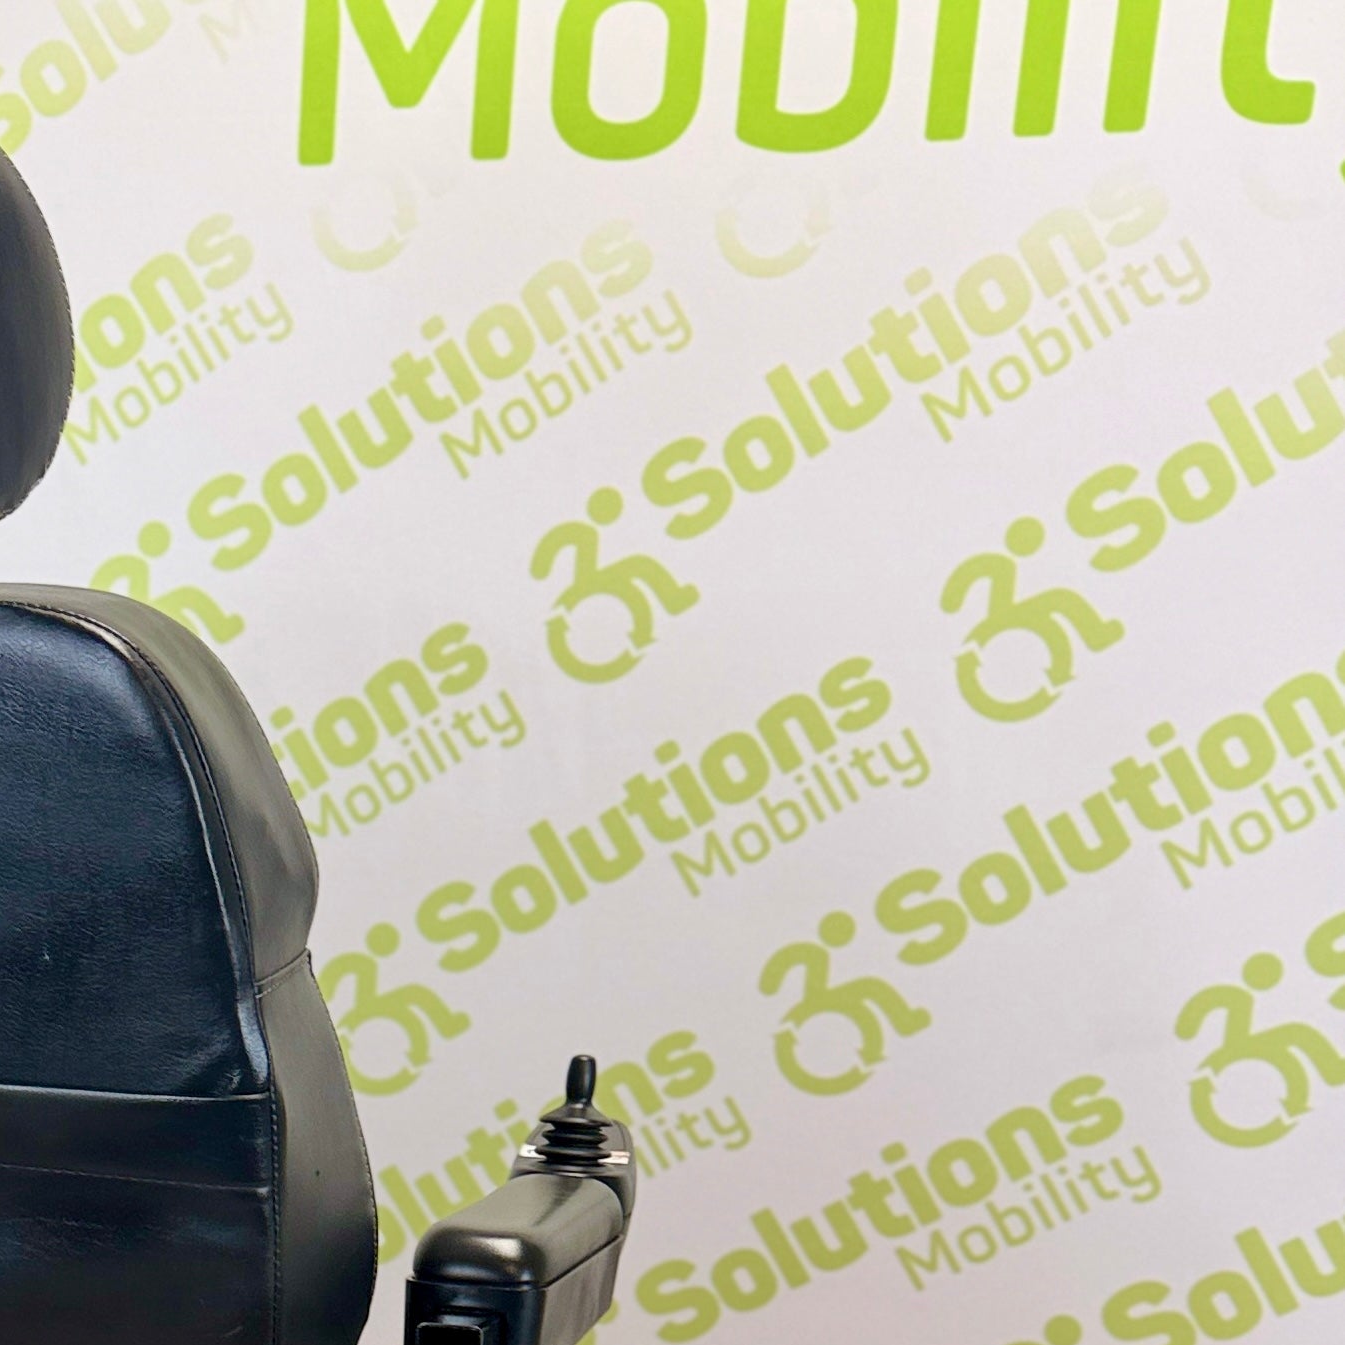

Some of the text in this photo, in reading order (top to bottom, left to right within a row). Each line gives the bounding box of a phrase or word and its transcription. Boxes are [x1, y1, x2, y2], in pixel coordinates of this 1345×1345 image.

[60, 281, 295, 467] Mobility
[187, 218, 653, 571] Solutions
[439, 288, 693, 480] Mobility
[642, 158, 1169, 540] Solutions
[919, 236, 1211, 444] Mobility
[1065, 327, 1345, 572] Solu
[416, 657, 891, 973] Solutions
[670, 727, 930, 898] Mobility
[874, 650, 1345, 966] Solution
[635, 1074, 1124, 1344] Solutions
[895, 1145, 1161, 1292] Mobility
